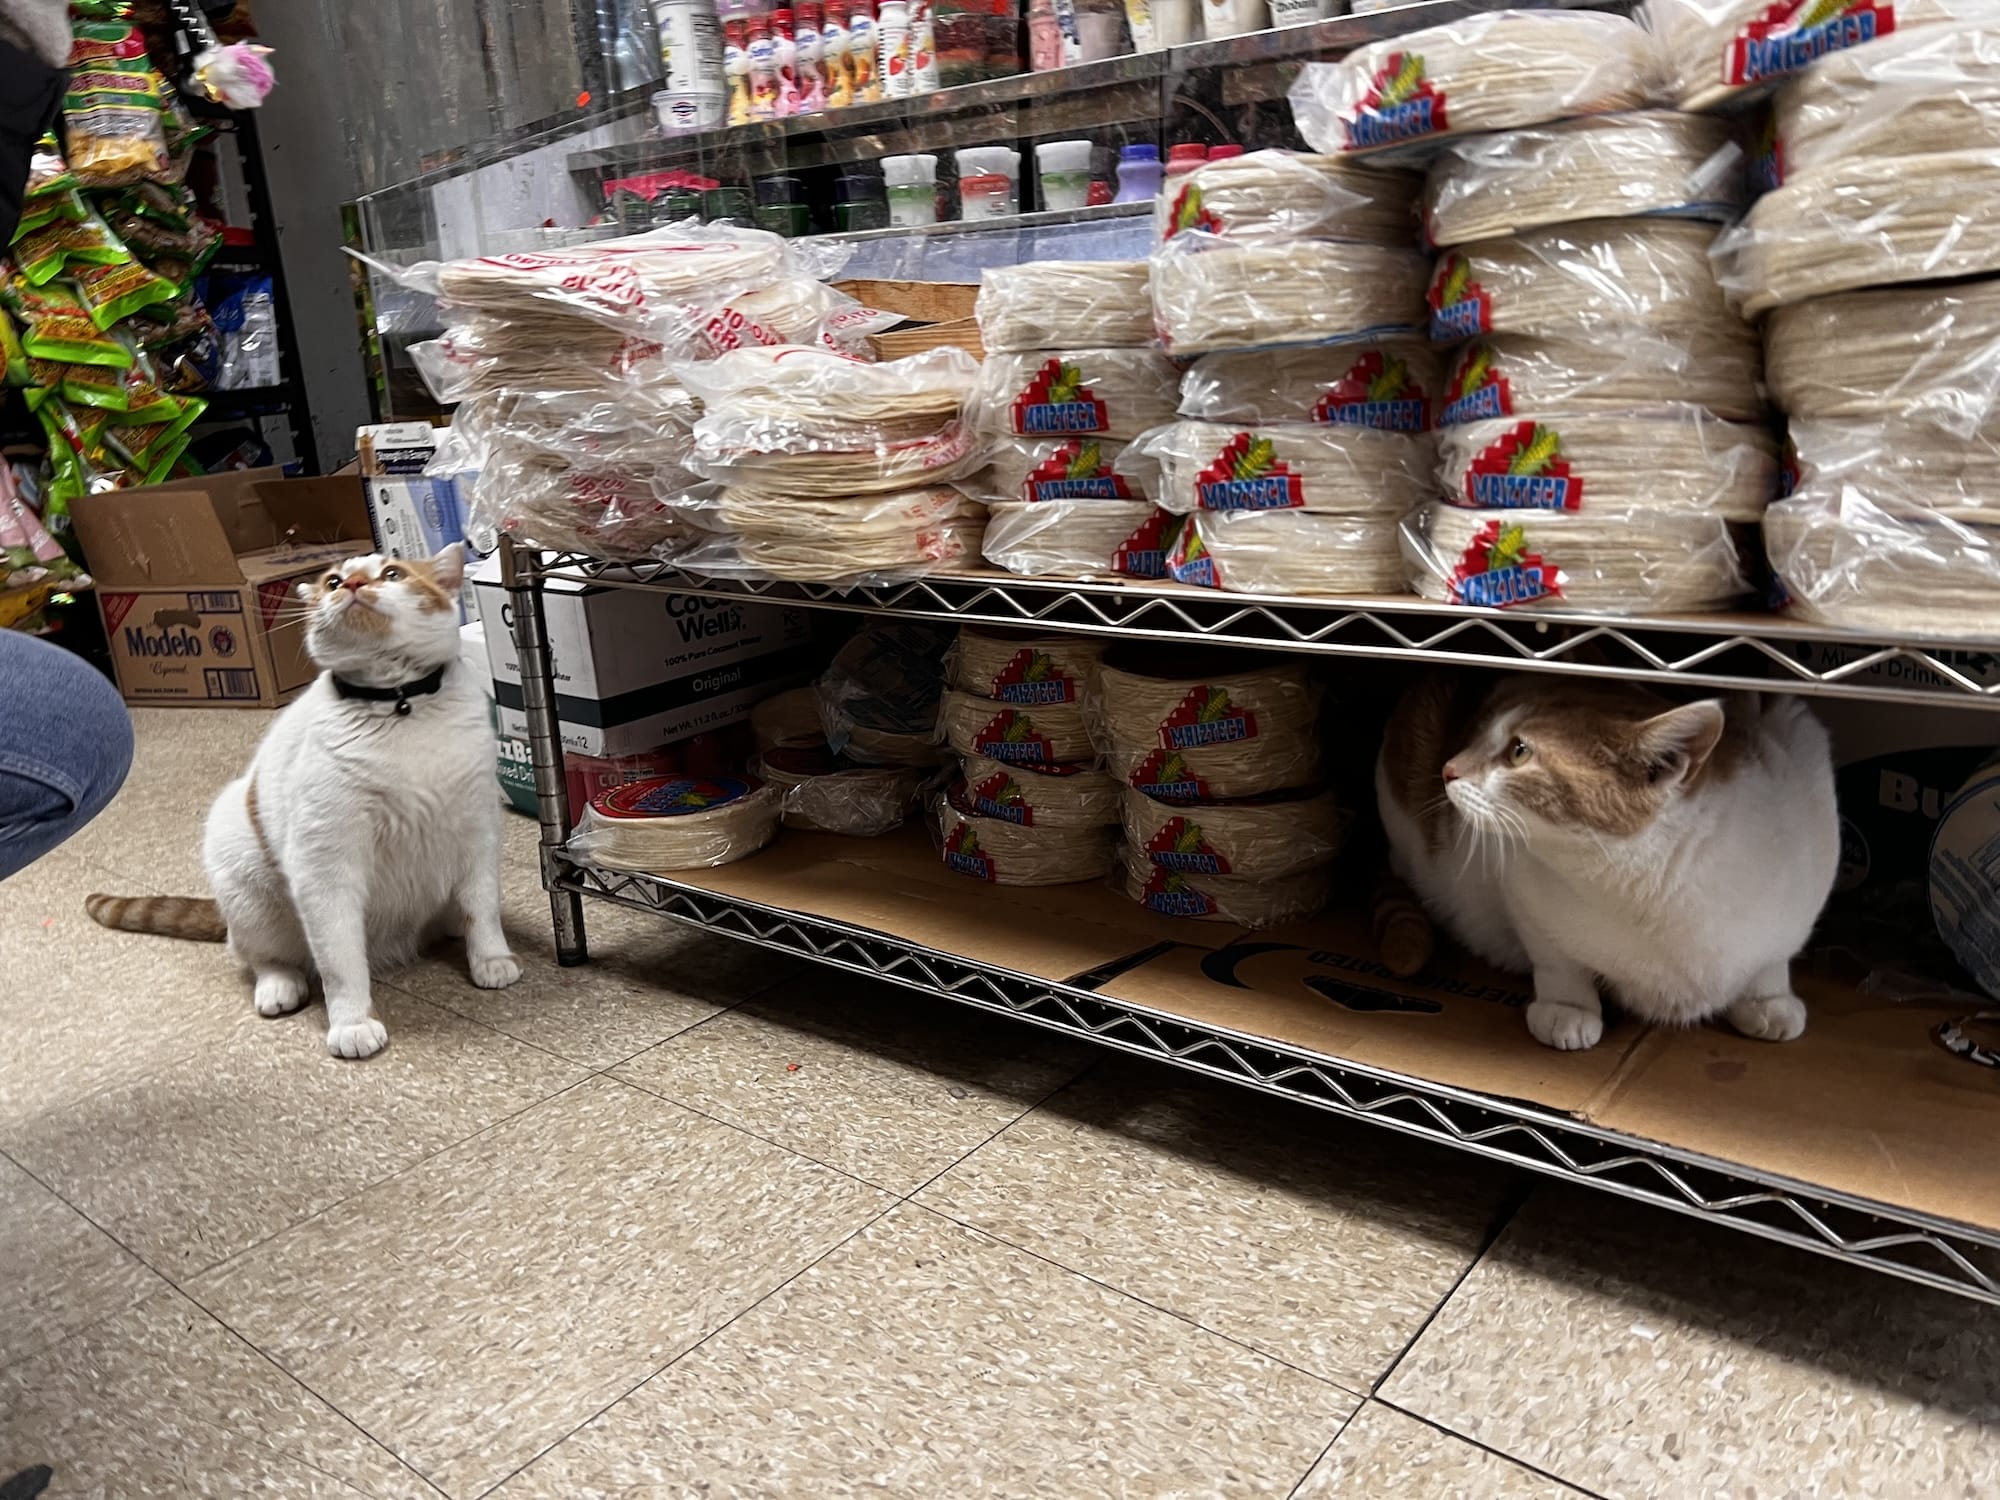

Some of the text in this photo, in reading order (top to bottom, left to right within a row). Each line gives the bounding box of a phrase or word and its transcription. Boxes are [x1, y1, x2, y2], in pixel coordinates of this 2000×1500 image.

[1024, 402, 1099, 433] MAIZTECA
[1202, 475, 1291, 511] MAIZTECA
[1472, 473, 1569, 510] MAIZTECA
[125, 626, 202, 658] Modelo
[692, 667, 742, 693] Original
[1001, 679, 1065, 705] MAIZTECA
[1170, 716, 1248, 750] MAIZTECA
